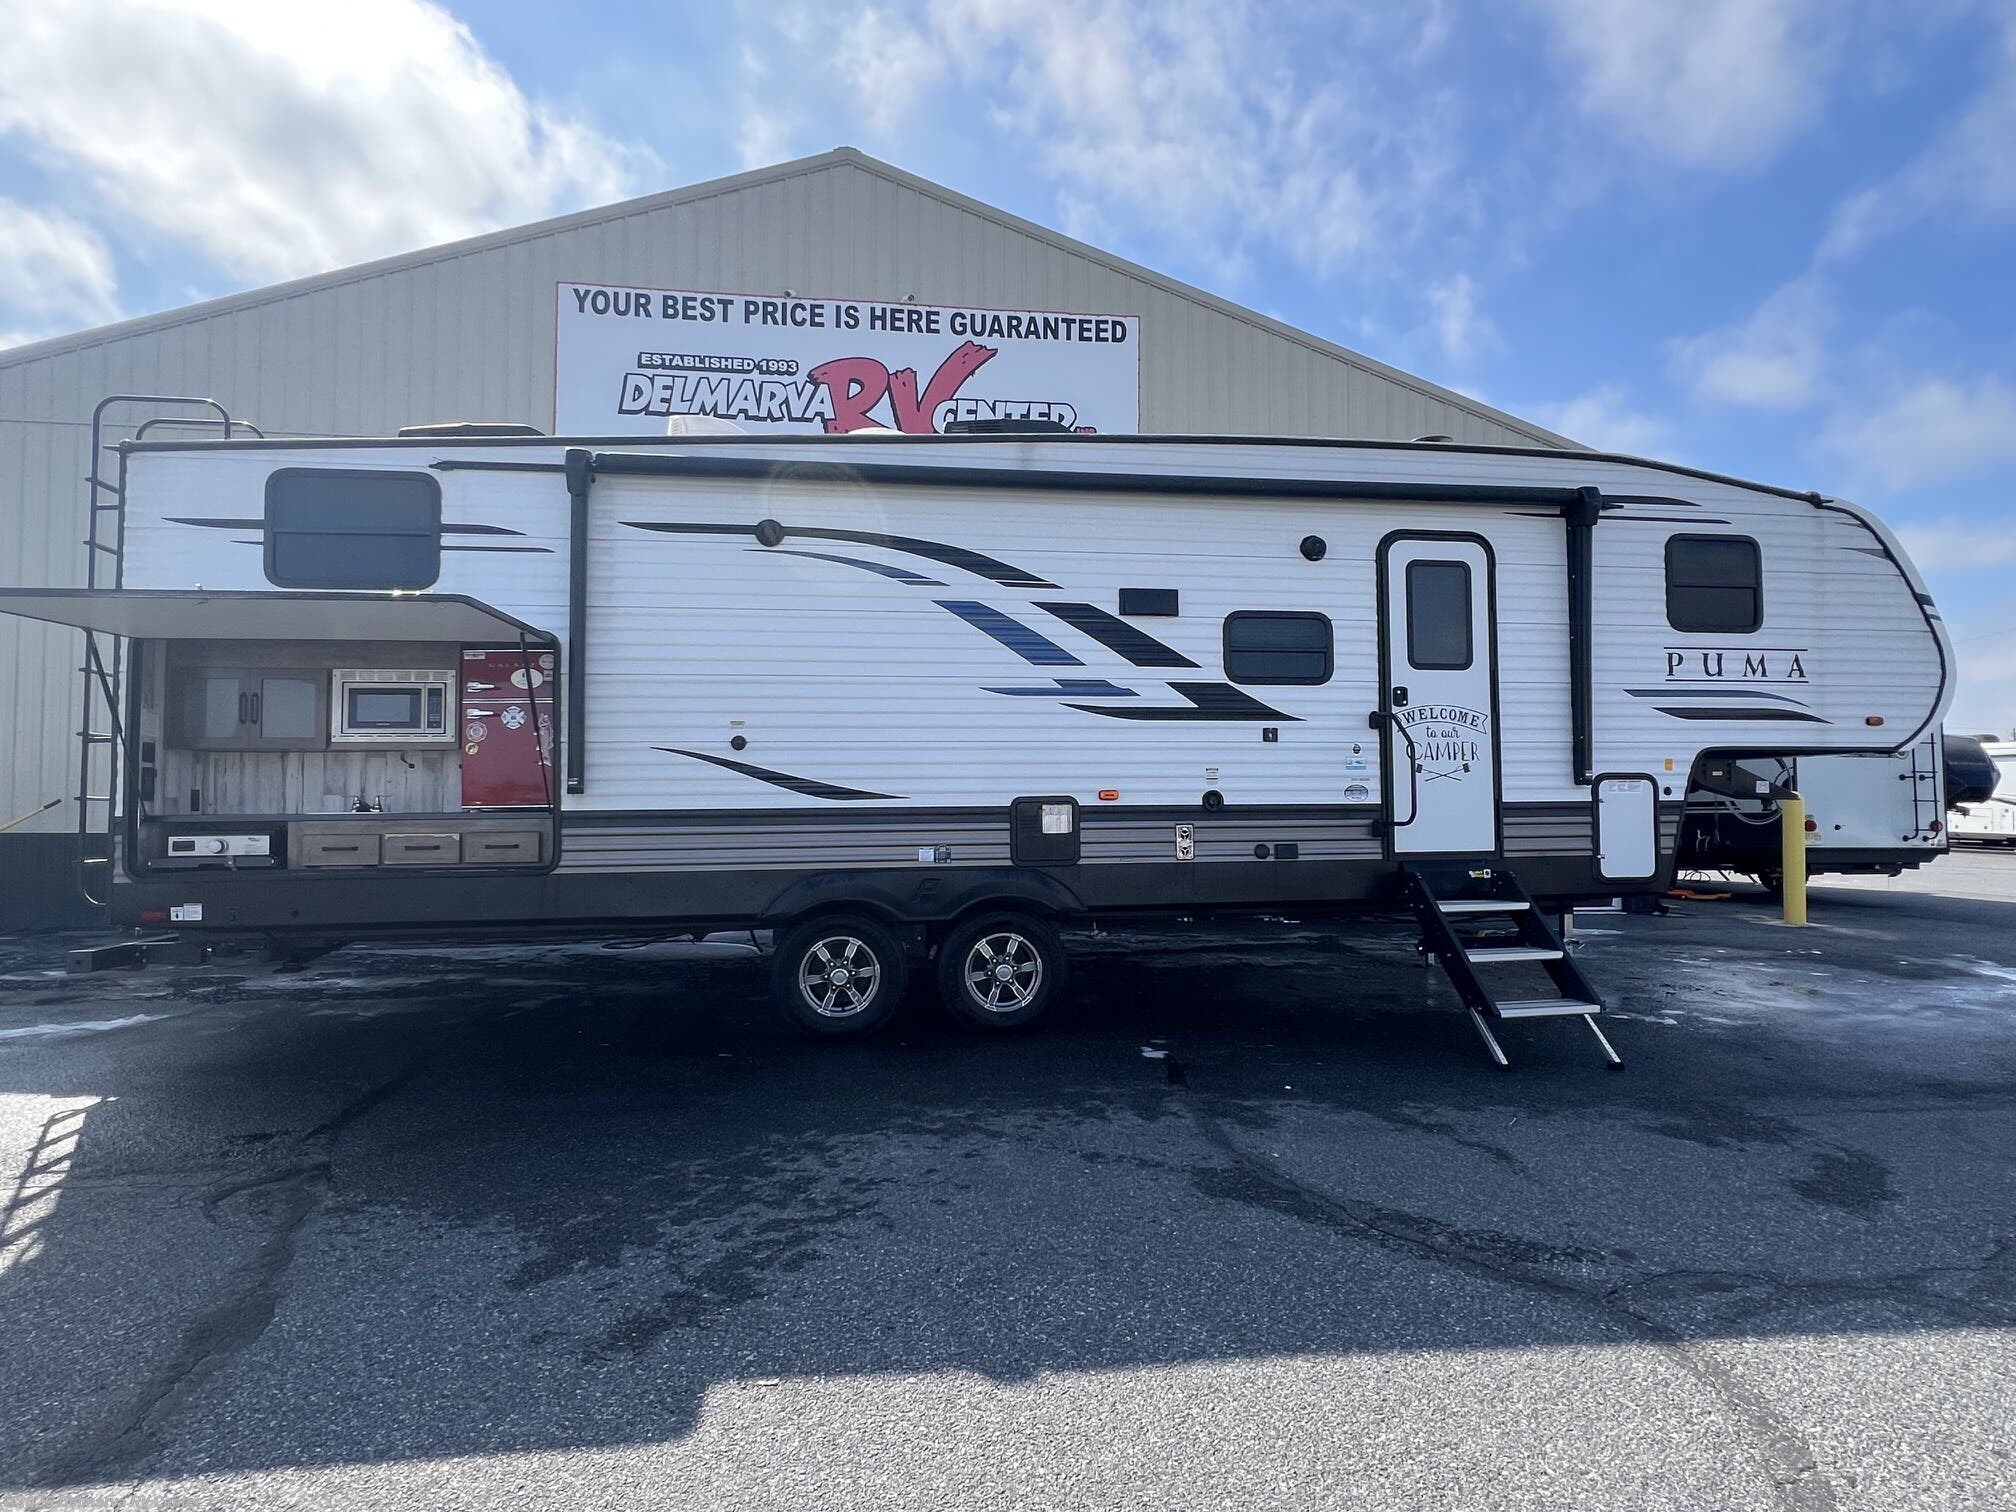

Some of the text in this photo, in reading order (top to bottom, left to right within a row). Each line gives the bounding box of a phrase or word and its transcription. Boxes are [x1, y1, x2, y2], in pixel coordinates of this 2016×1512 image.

[572, 288, 1128, 343] YOUR BEST PRICE IS HERE GUARANTEED
[639, 352, 799, 374] ESTABLISHED 1993
[618, 372, 836, 422] DELMARVA
[807, 340, 998, 434] RV
[1666, 652, 1807, 678] PUMA
[1402, 707, 1480, 728] WELCOME
[1425, 725, 1461, 739] to our
[1406, 741, 1481, 761] CAMPER
